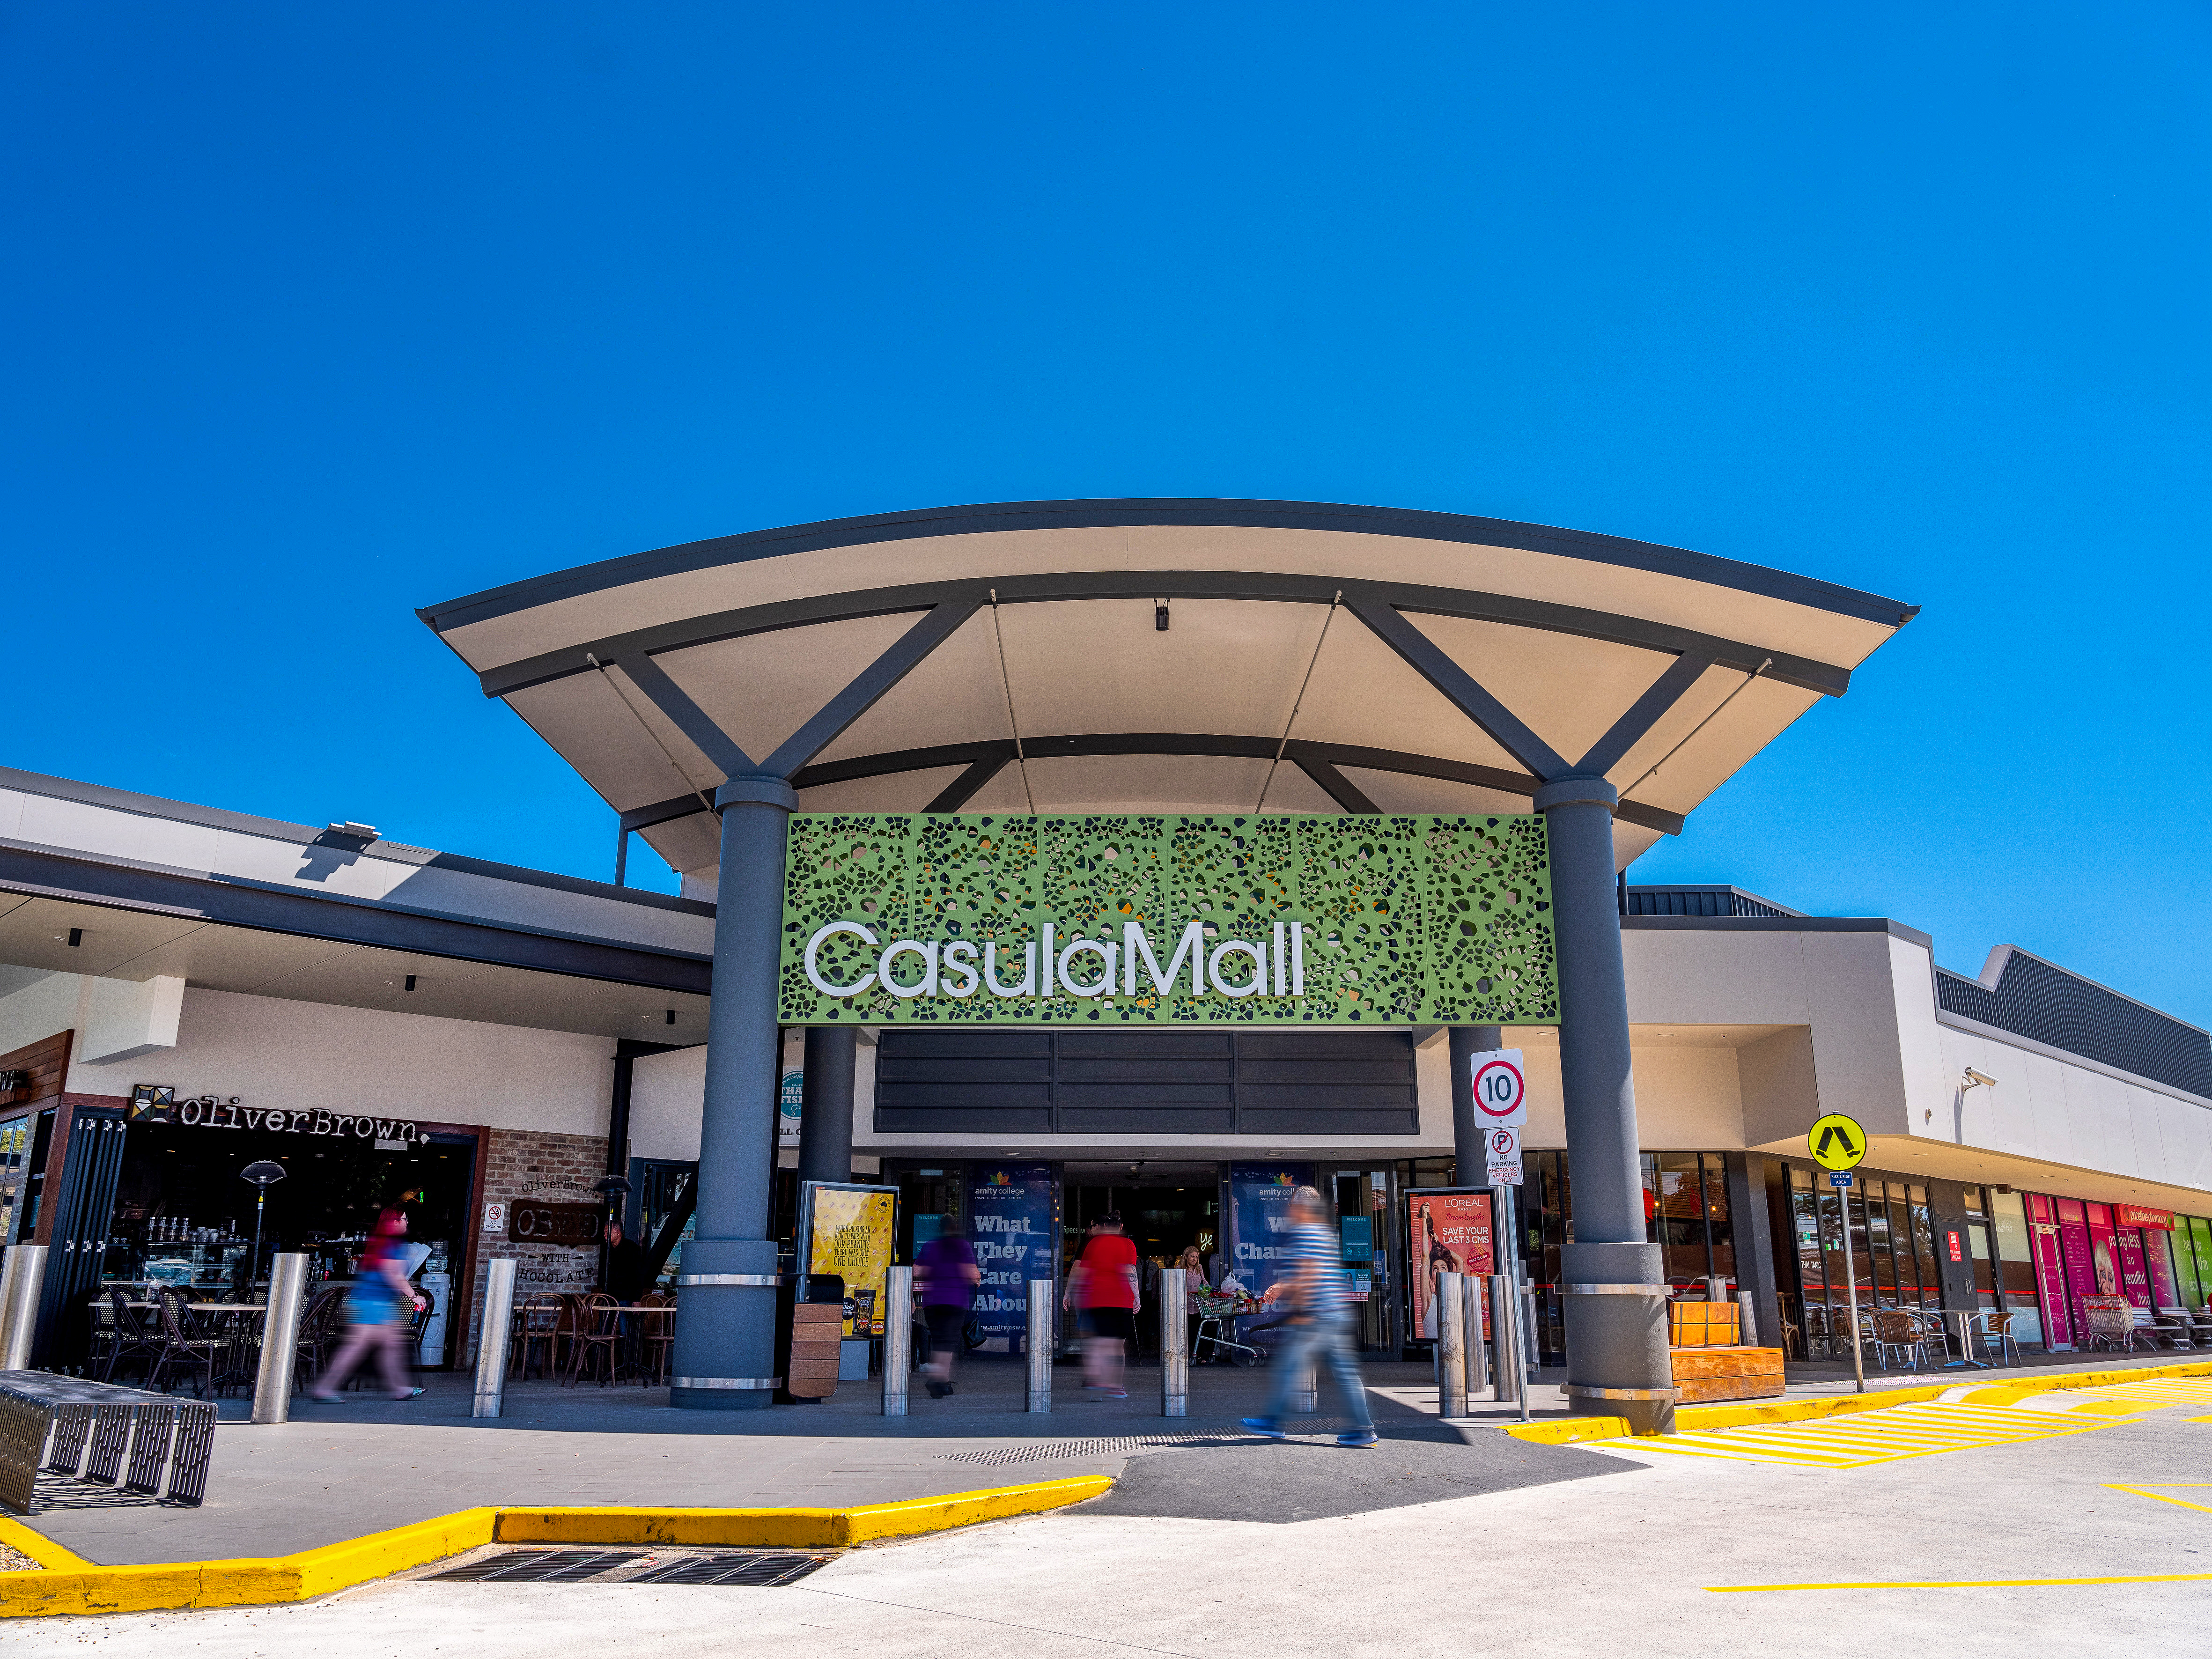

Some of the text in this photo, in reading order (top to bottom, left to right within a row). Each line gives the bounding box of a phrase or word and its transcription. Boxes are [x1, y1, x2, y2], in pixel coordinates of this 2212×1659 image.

[804, 921, 1304, 997] CasulaMall
[1485, 1075, 1512, 1102] 10
[975, 1187, 1025, 1196] amity college
[1259, 1188, 1282, 1197] amity
[1445, 1198, 1484, 1208] L'ORÉAL
[974, 1216, 1030, 1232] What
[1464, 1212, 1485, 1225] lengths
[2131, 1209, 2167, 1227] priceline pharmacy
[1466, 1226, 1489, 1235] YOUR
[834, 1239, 870, 1249] OUR PEANUTS
[1472, 1235, 1489, 1244] CMS
[2109, 1229, 2140, 1251] paing less
[541, 1253, 570, 1263] WITH
[973, 1242, 1028, 1261] They
[834, 1256, 869, 1267] ONE CHOICE
[2126, 1254, 2135, 1265] is a
[519, 1267, 595, 1283] HOCOLATE
[2189, 1277, 2209, 1292] sickess
[972, 1295, 1026, 1311] Abou
[2137, 1291, 2151, 1309] thing
